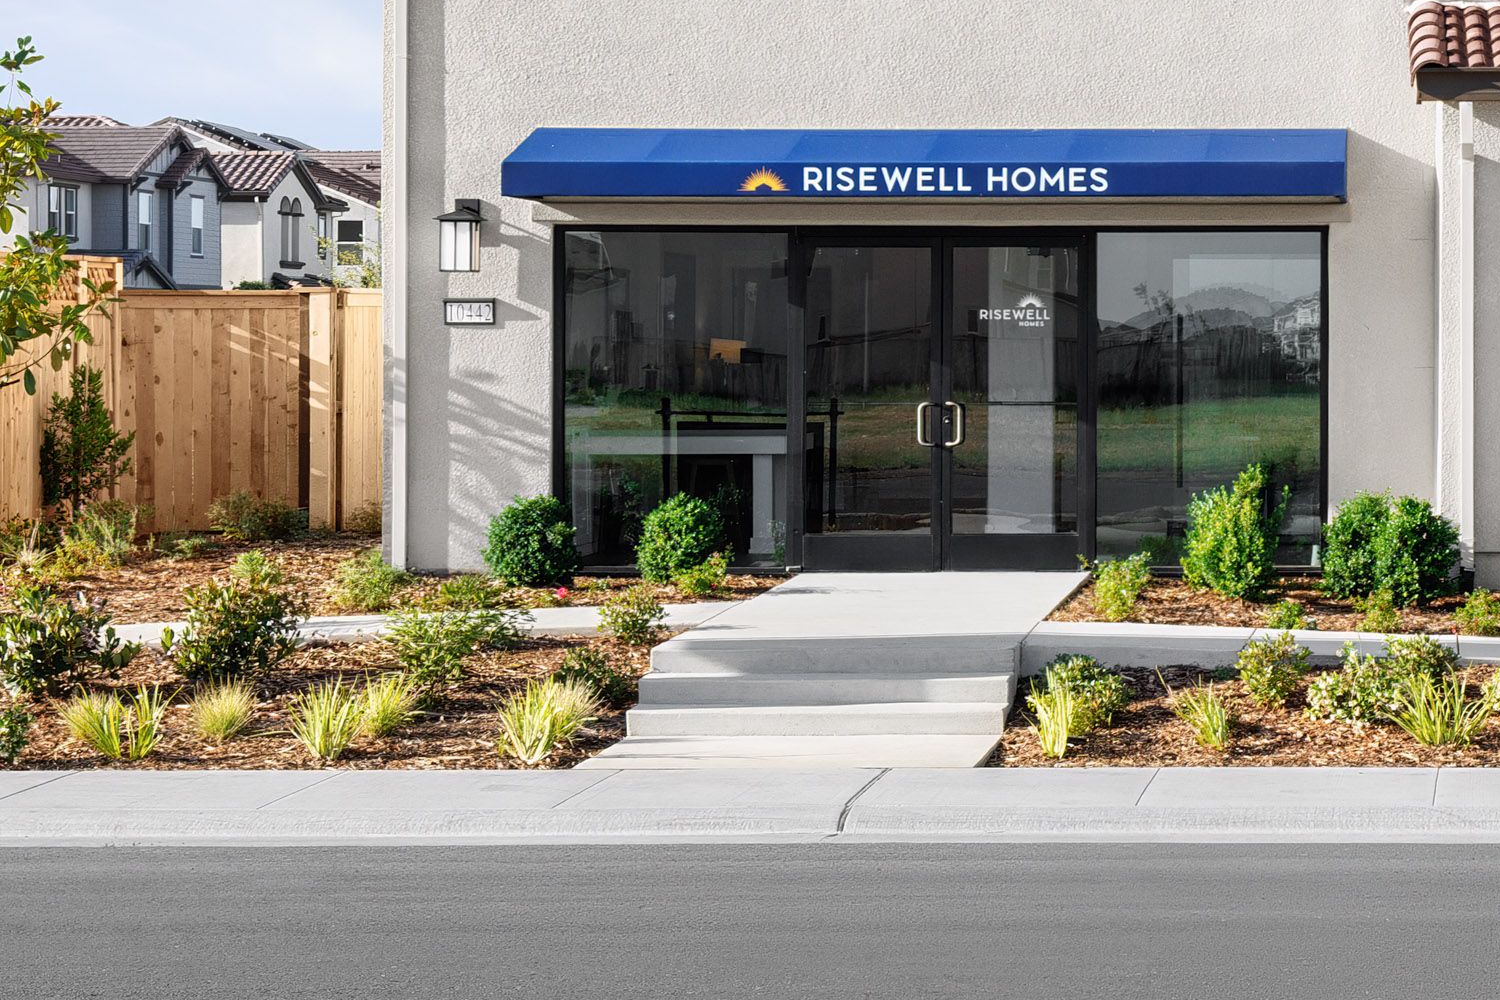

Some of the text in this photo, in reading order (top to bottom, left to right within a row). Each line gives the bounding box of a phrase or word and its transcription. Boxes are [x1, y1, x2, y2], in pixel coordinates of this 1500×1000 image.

[803, 166, 1109, 192] RISEWELL HOMES
[448, 303, 492, 322] 10442
[979, 309, 1051, 320] RISEWELL
